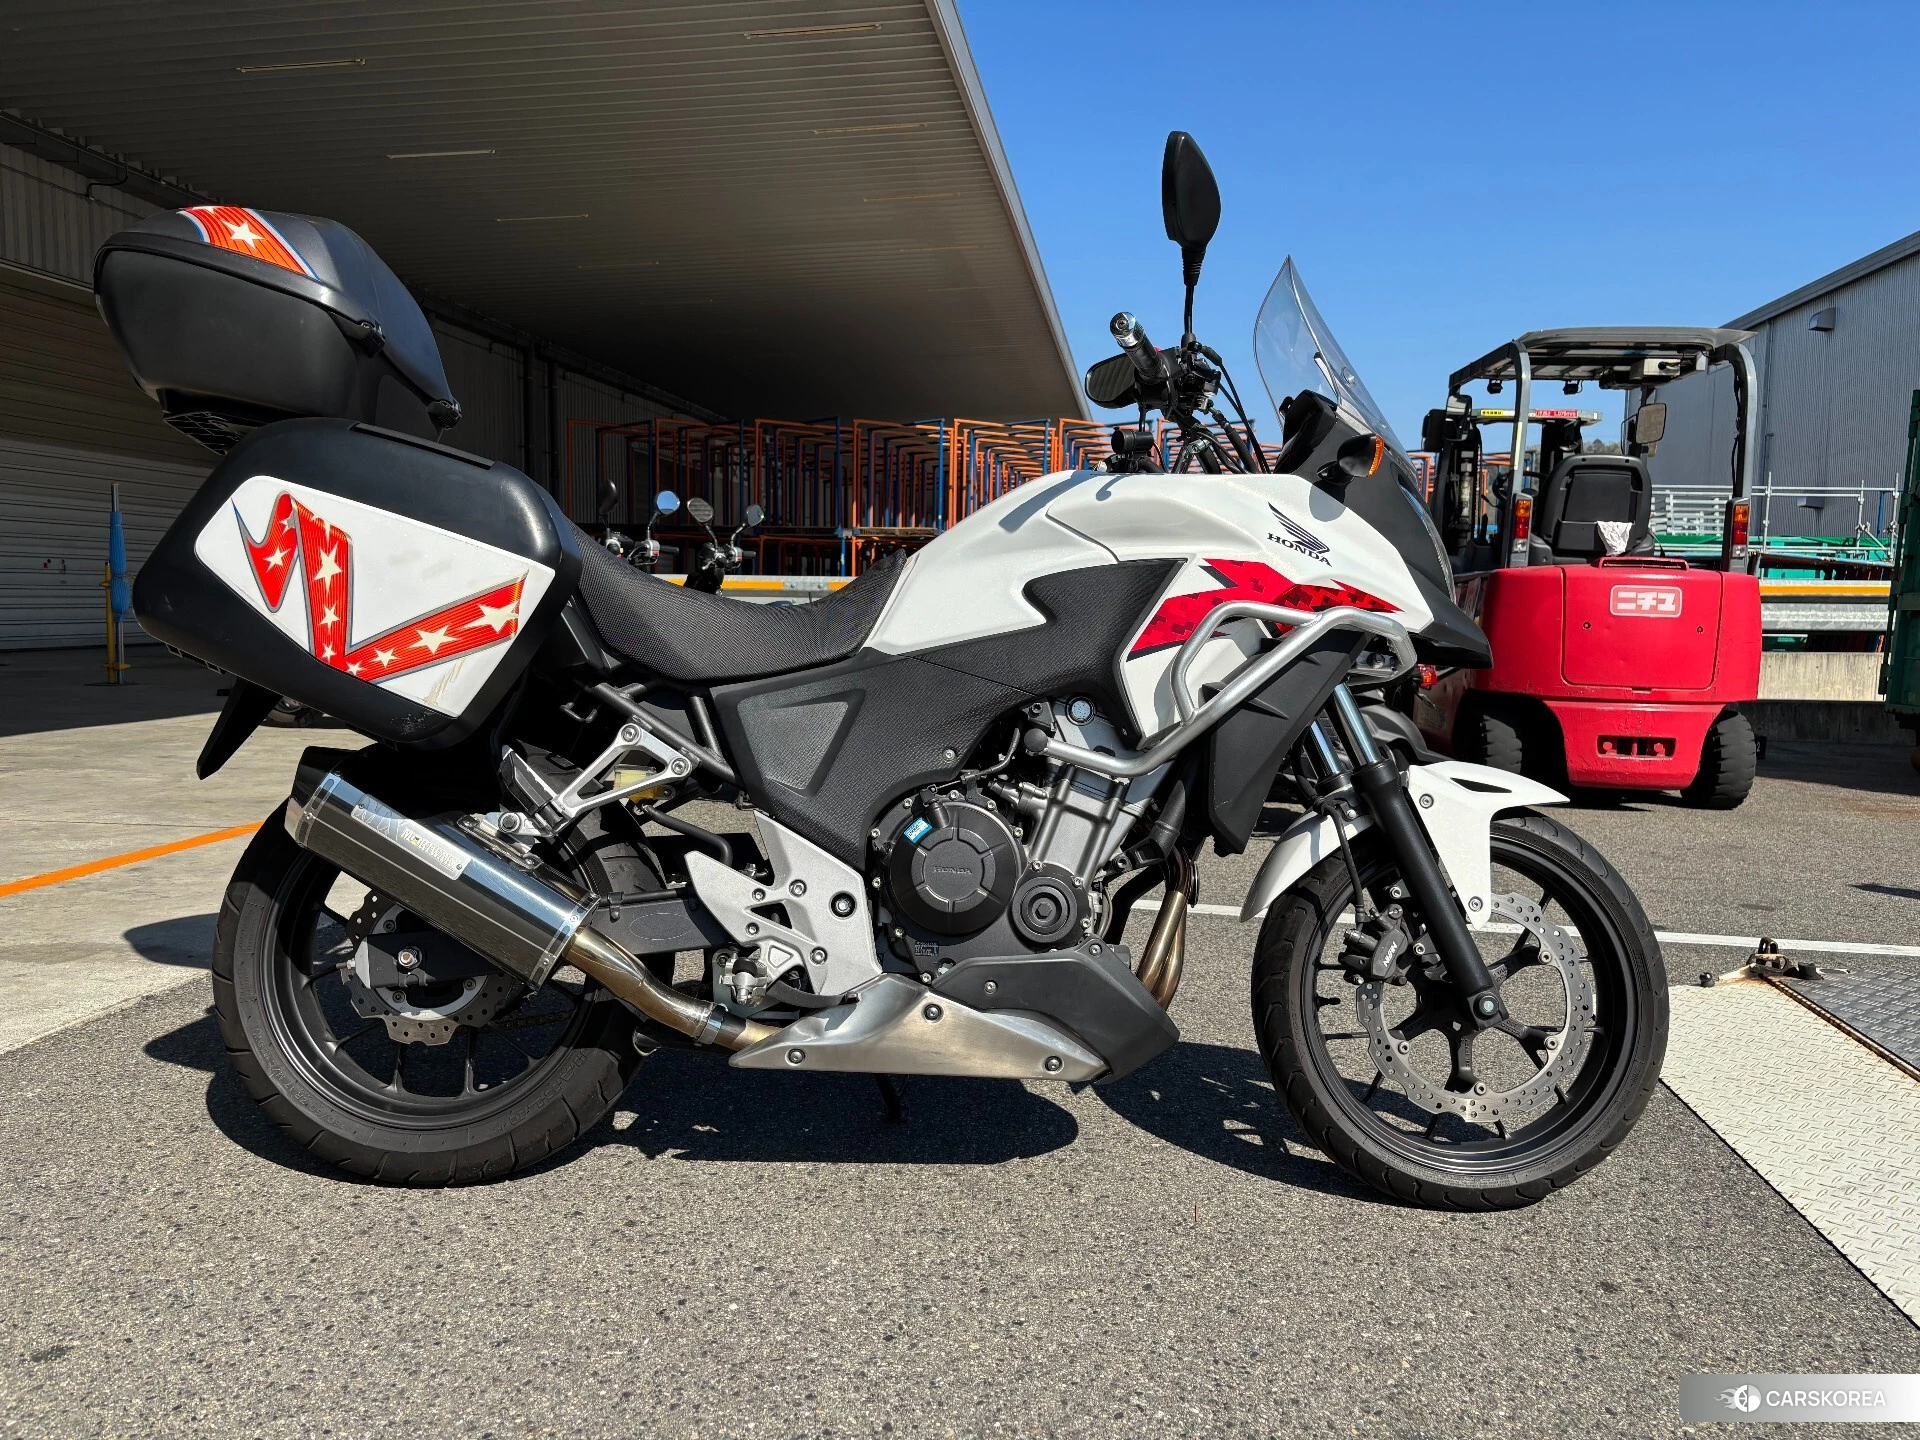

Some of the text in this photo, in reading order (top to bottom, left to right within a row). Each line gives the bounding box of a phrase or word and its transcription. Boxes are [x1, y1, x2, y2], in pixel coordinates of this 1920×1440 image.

[1267, 532, 1333, 568] HONDA
[1616, 591, 1677, 612] ニチユ
[933, 865, 973, 875] HONDA
